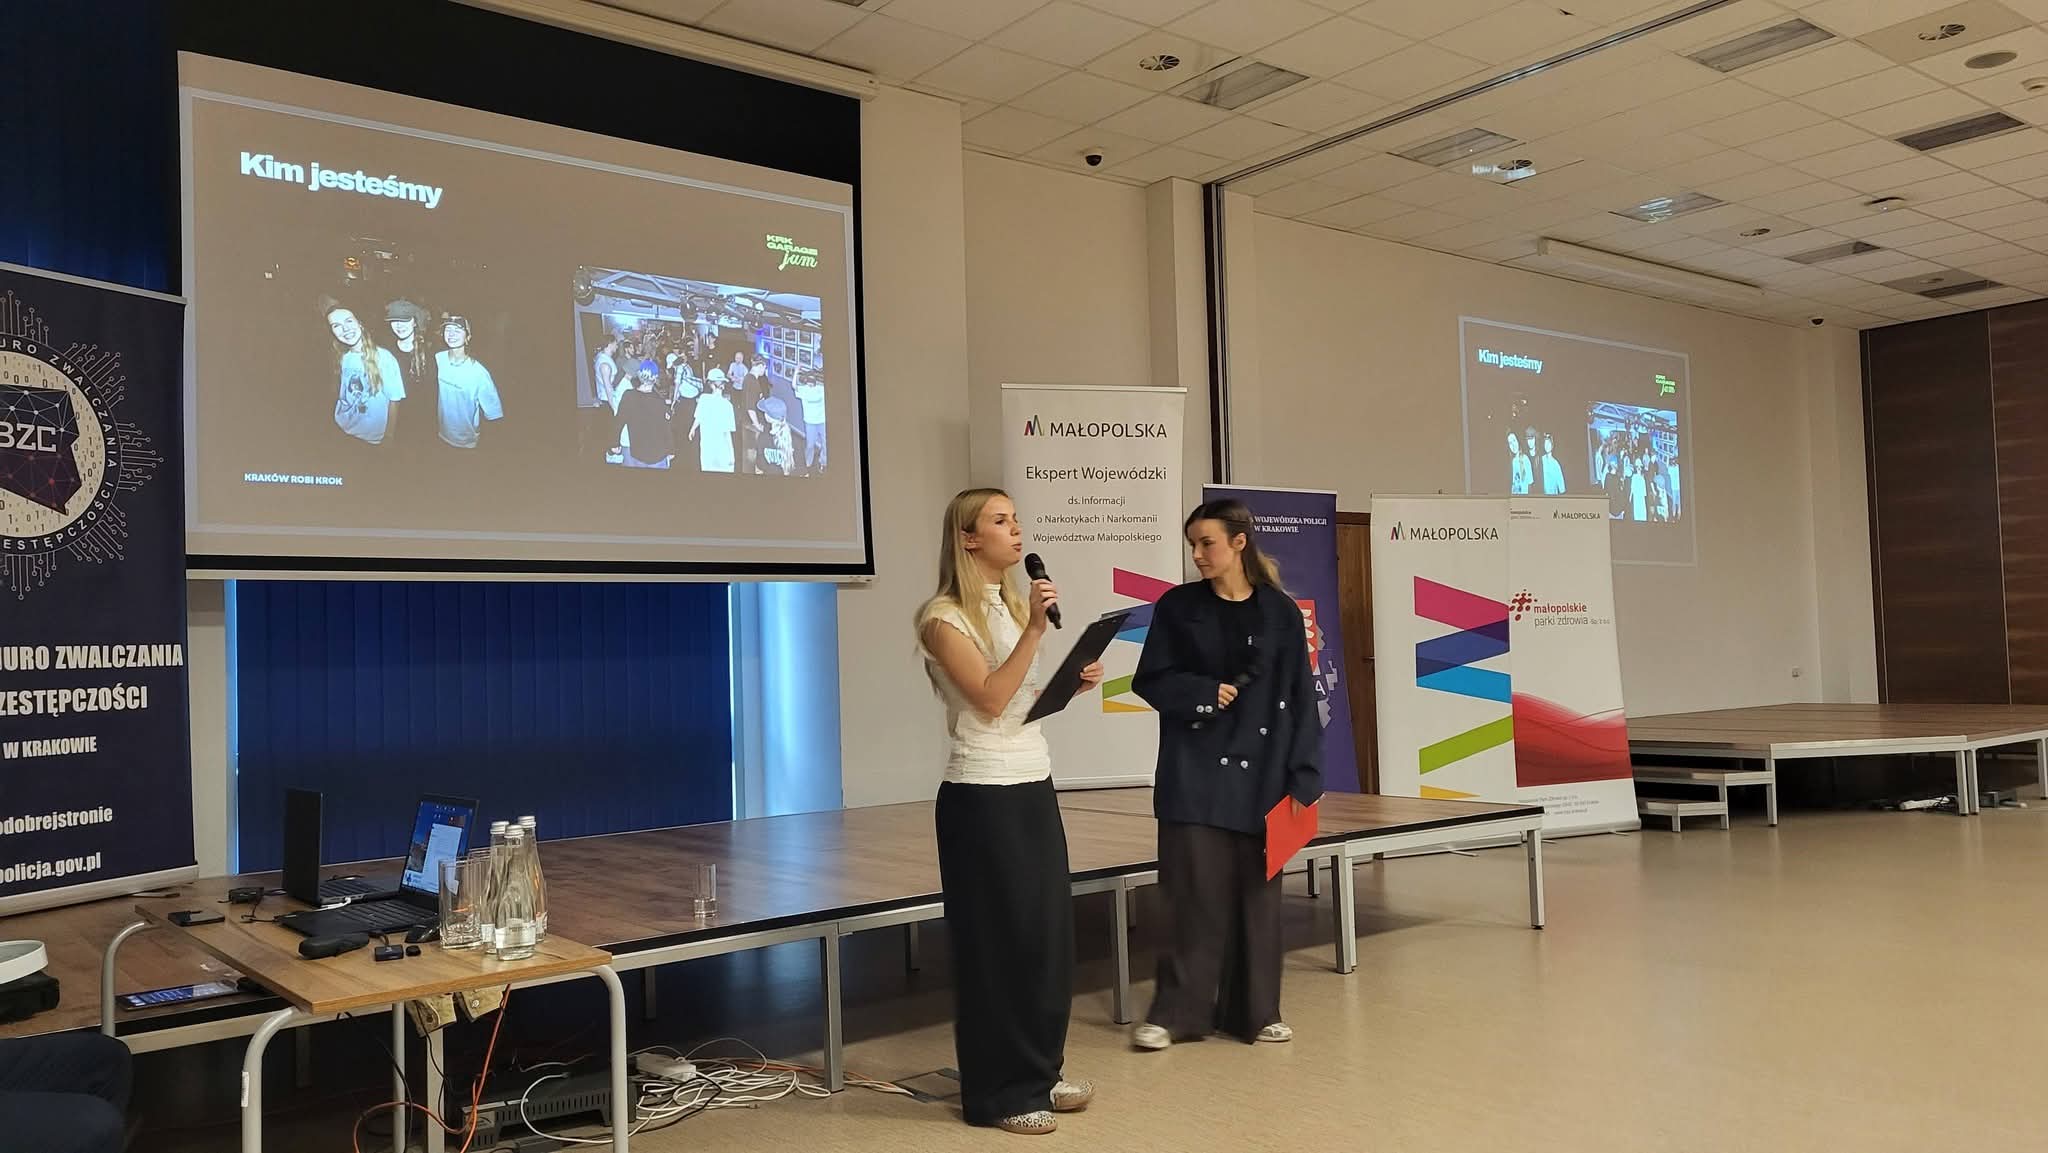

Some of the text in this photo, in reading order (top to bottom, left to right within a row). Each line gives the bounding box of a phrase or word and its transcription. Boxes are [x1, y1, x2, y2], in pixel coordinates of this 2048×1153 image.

[240, 151, 443, 209] Kim jesteśmy
[766, 234, 793, 245] KRK
[1479, 349, 1543, 374] Kim jesteśmy
[49, 354, 117, 467] ZWALCZANIA
[1050, 422, 1167, 438] MAŁOPOLSKA
[244, 473, 343, 486] KRAKÓW ROBI KROK
[1026, 466, 1167, 483] Ekspert Wojewódzki
[1067, 495, 1126, 507] ds. Informacji
[1044, 514, 1100, 526] Narkotykach
[1106, 514, 1158, 523] Narkomanii
[1254, 515, 1303, 524] WOJEWÓDZKA
[1561, 512, 1601, 520] MAŁOPOLSKA
[1262, 525, 1300, 533] KRAKOWIE
[1410, 527, 1499, 541] MAŁOPOLSKA
[1032, 532, 1162, 544] Województwa Małopolskiego
[1533, 602, 1588, 615] małopolskie
[1534, 615, 1555, 629] parki
[1557, 615, 1589, 626] zdrowia
[55, 644, 184, 670] ZWALCZANIA
[3, 736, 97, 760] W KRAKOWIE
